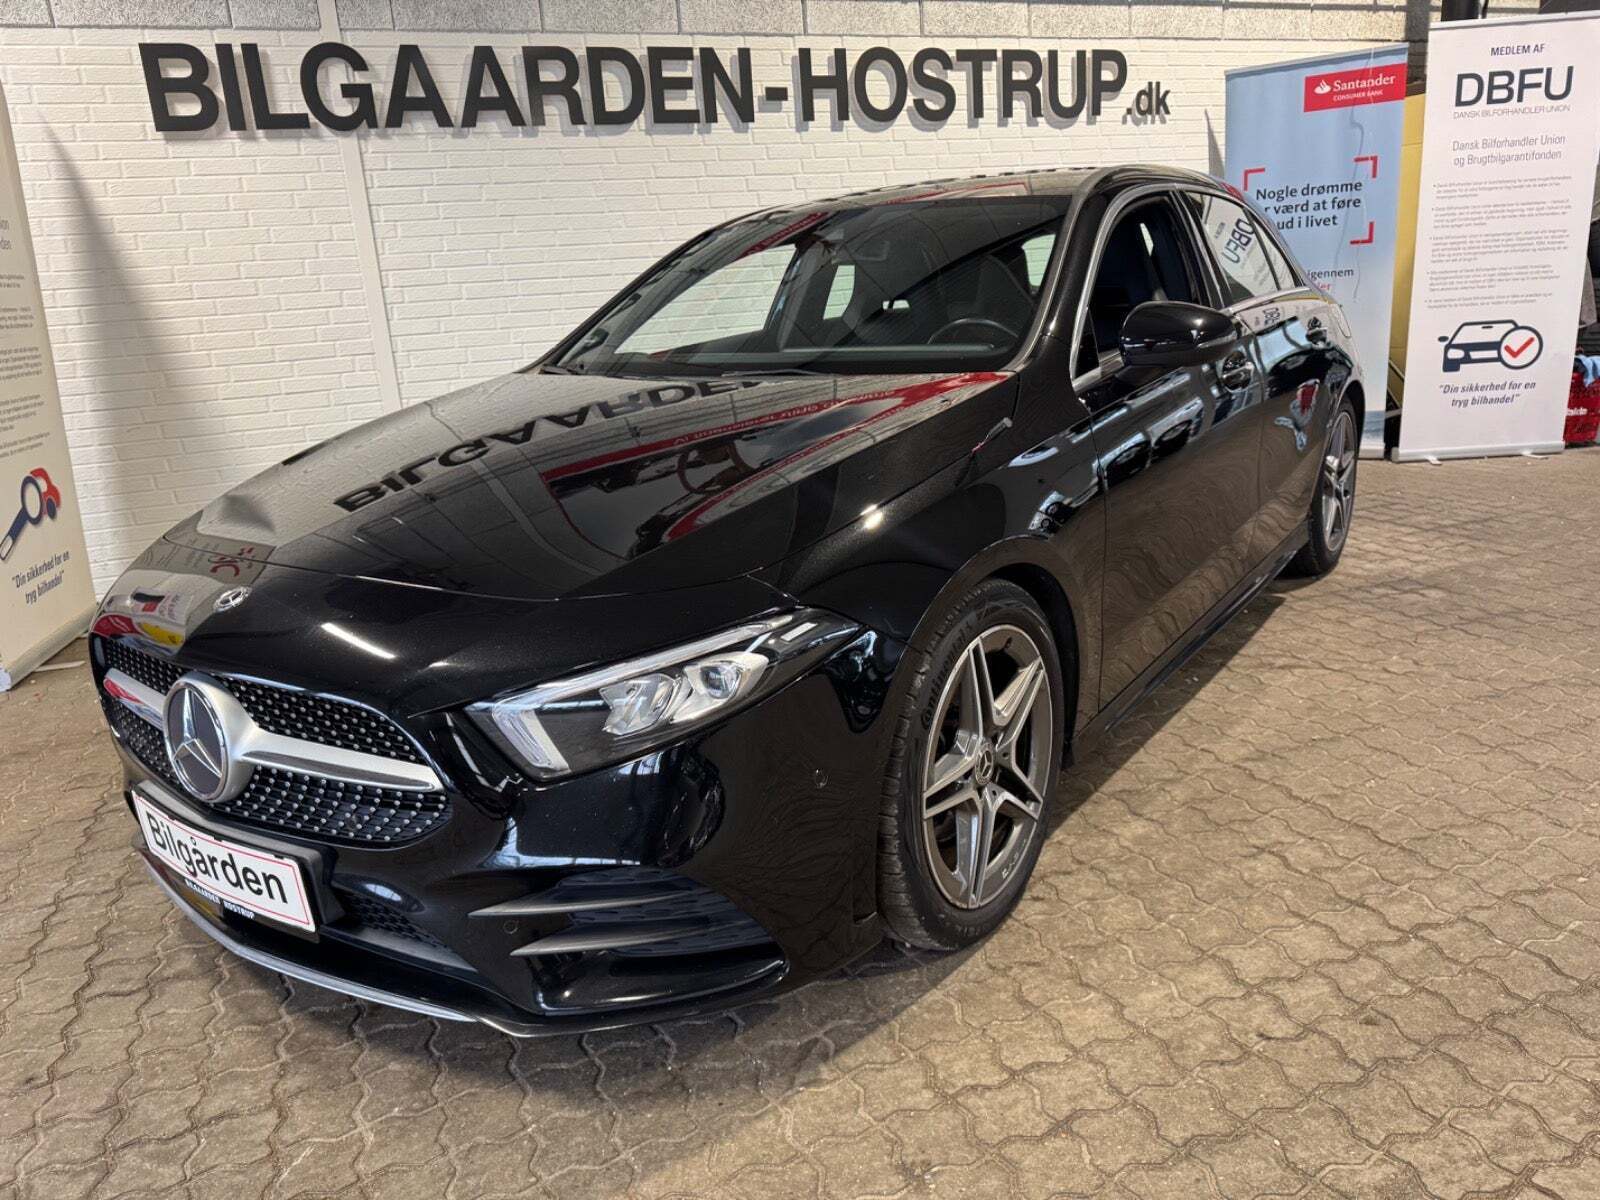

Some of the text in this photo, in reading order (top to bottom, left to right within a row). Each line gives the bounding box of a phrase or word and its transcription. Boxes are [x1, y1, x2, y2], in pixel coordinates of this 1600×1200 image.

[1490, 43, 1546, 56] MEDLEM AF
[1333, 73, 1396, 91] Santander
[1455, 65, 1574, 107] DBFU
[1367, 89, 1384, 97] BANK
[1453, 104, 1571, 120] DANSK BILFORHANDLER UNION
[1452, 134, 1566, 151] Dansk Bilforhandler Union
[1453, 157, 1465, 168] og
[1256, 181, 1362, 203] Nogle drømme
[1273, 201, 1309, 214] værd
[1313, 201, 1328, 211] at
[1331, 198, 1361, 209] føre
[1298, 217, 1302, 228] i
[1305, 215, 1338, 227] livet
[1460, 382, 1506, 393] sikkerhed
[1508, 381, 1522, 391] for
[1524, 381, 1536, 389] en
[1451, 397, 1469, 408] tryg
[27, 556, 55, 582] sikkerhed
[146, 811, 288, 904] Bilgården
